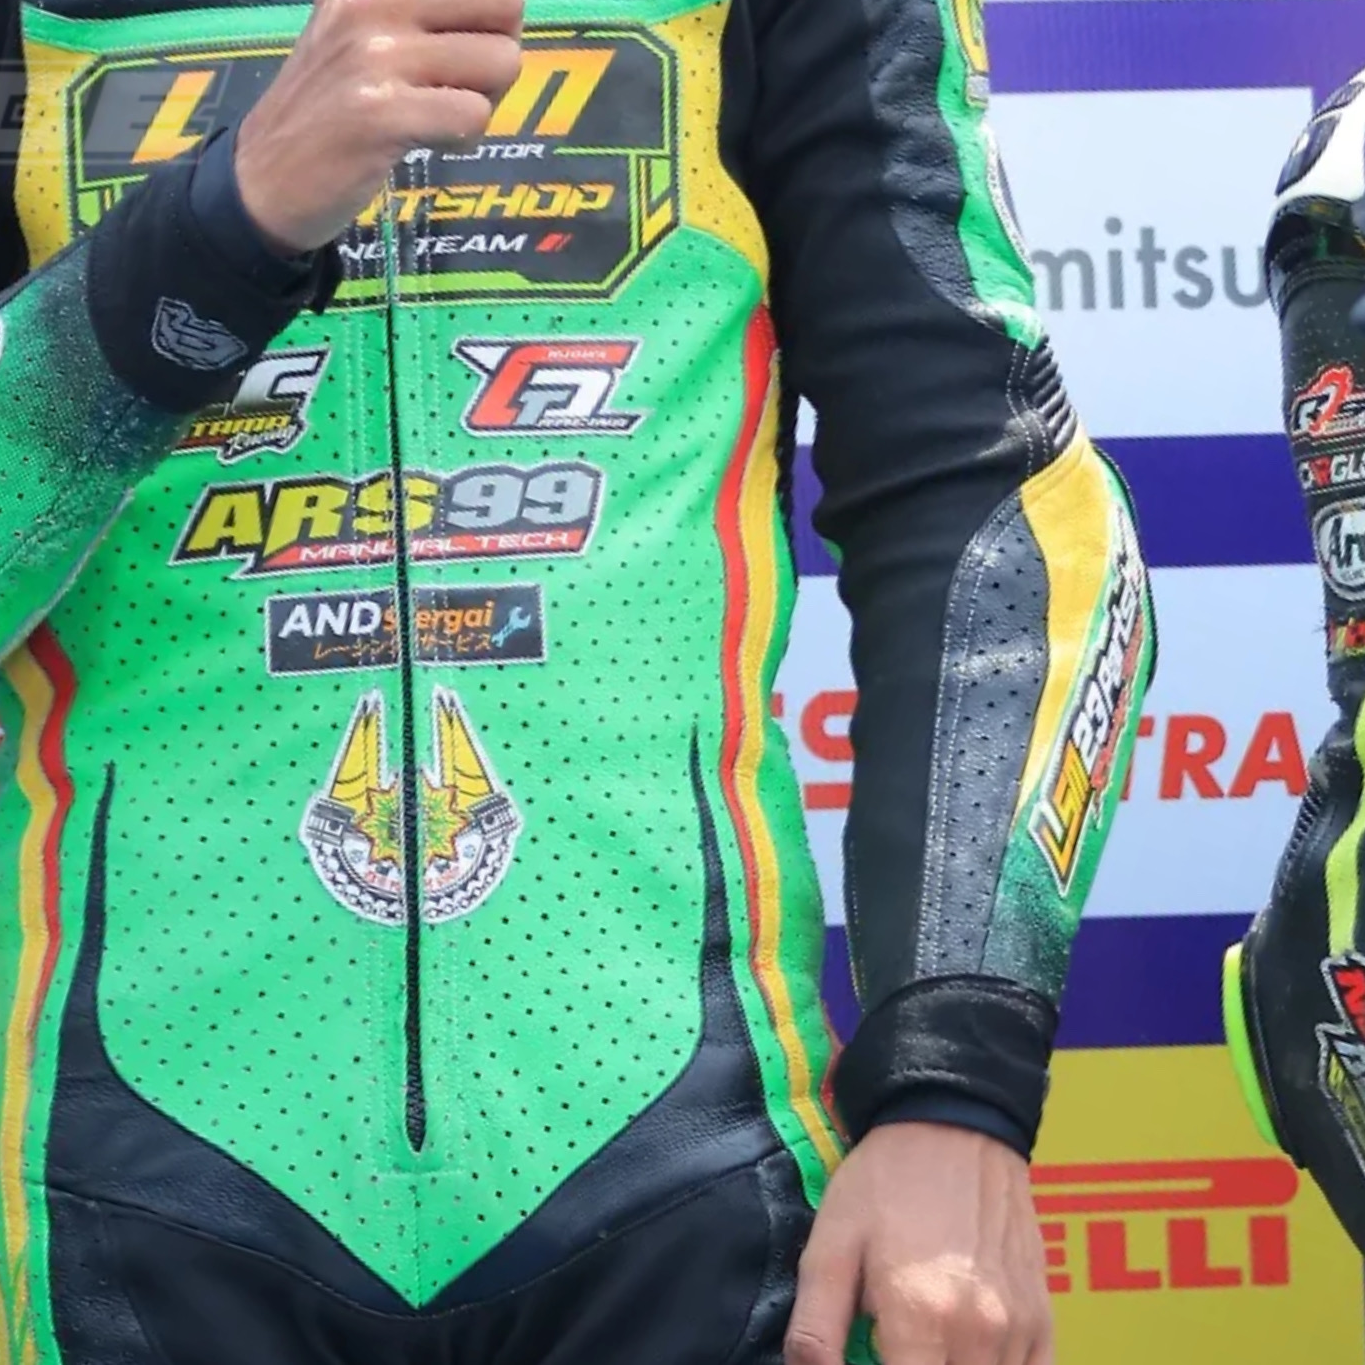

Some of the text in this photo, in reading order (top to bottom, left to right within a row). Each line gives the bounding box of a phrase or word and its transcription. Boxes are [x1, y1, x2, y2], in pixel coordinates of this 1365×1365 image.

[415, 233, 529, 256] TEAM
[185, 469, 597, 558] ARS99
[474, 531, 571, 548] TECH
